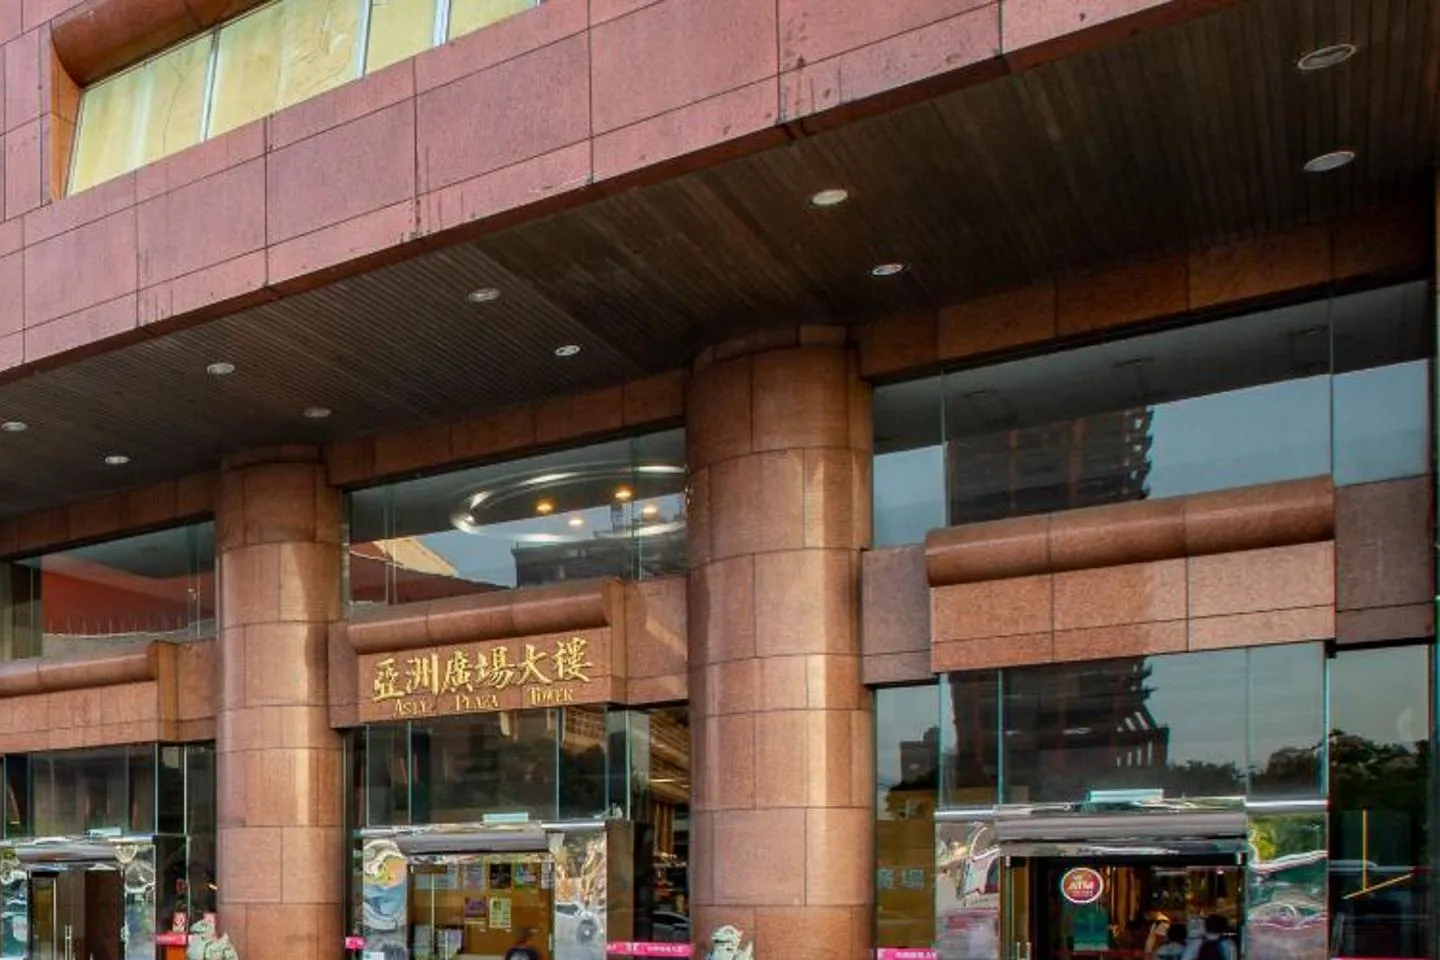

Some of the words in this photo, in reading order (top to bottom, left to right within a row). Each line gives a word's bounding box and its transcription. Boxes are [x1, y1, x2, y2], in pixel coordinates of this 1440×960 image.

[372, 637, 592, 701] 亞洲廣場大樓
